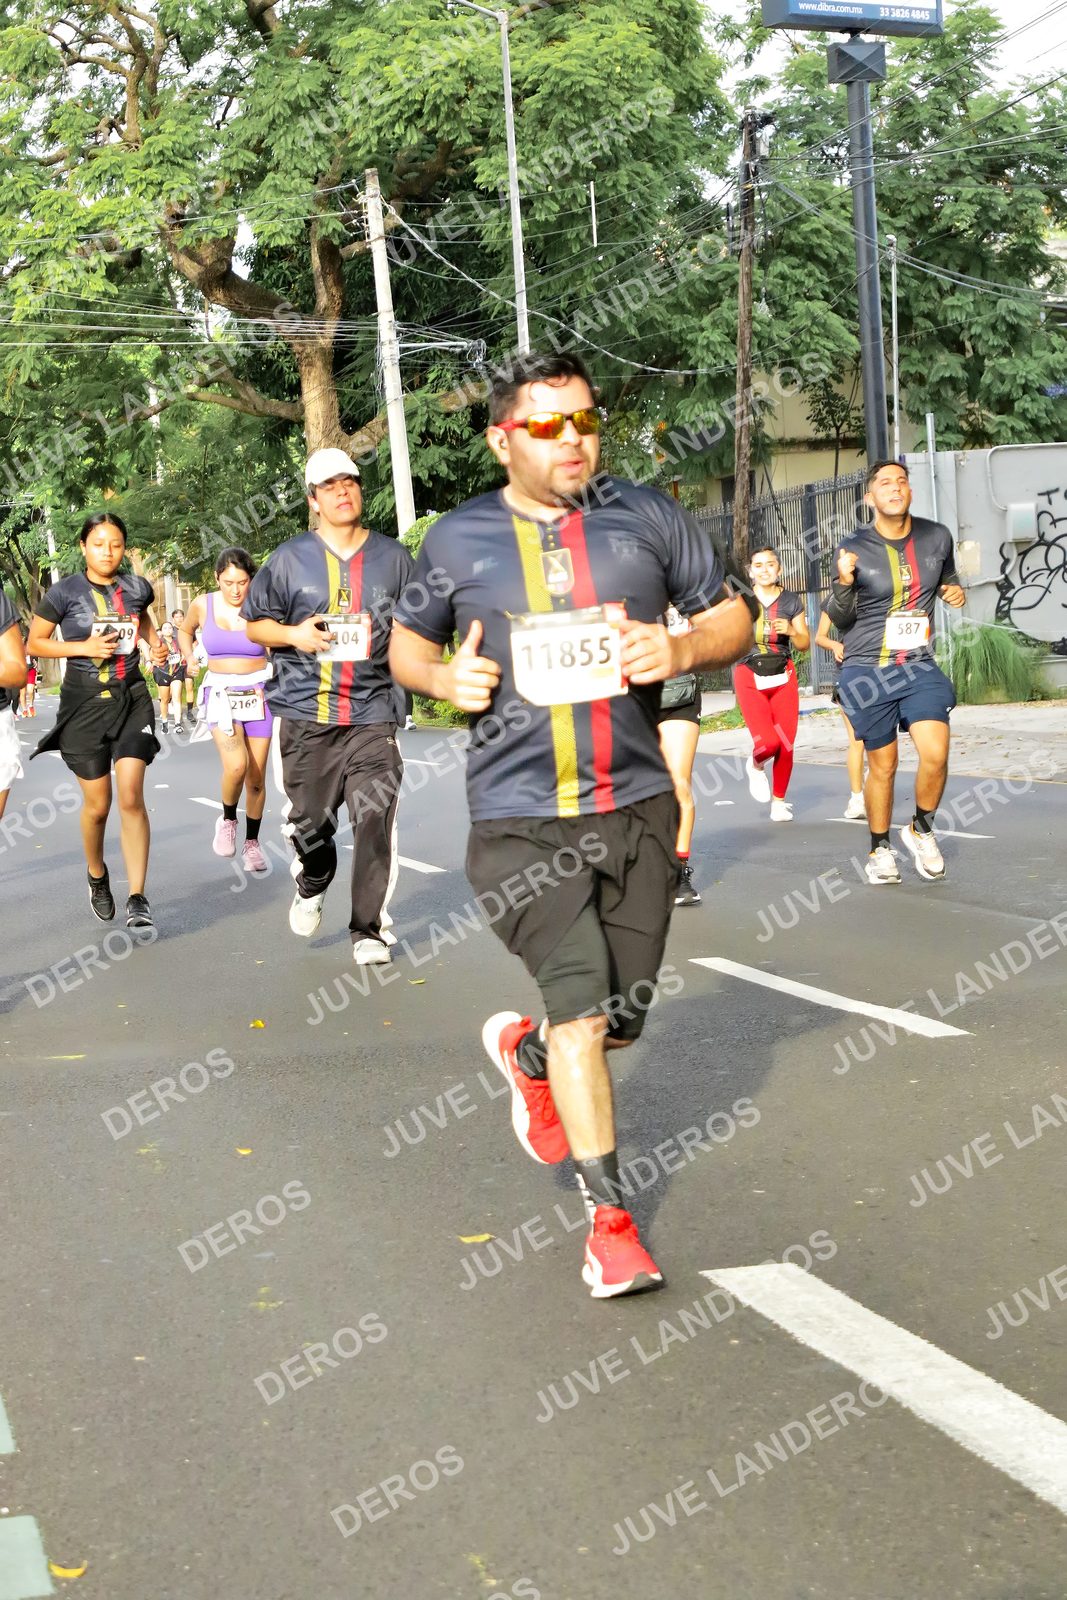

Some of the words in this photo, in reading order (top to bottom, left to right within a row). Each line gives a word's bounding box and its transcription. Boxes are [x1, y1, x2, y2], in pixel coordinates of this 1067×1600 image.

[799, 2, 863, 14] www.dibra.com.mx
[879, 7, 889, 17] 33
[891, 8, 910, 18] 3826
[911, 9, 930, 20] 4845
[897, 622, 920, 635] 587
[521, 636, 612, 671] 11855
